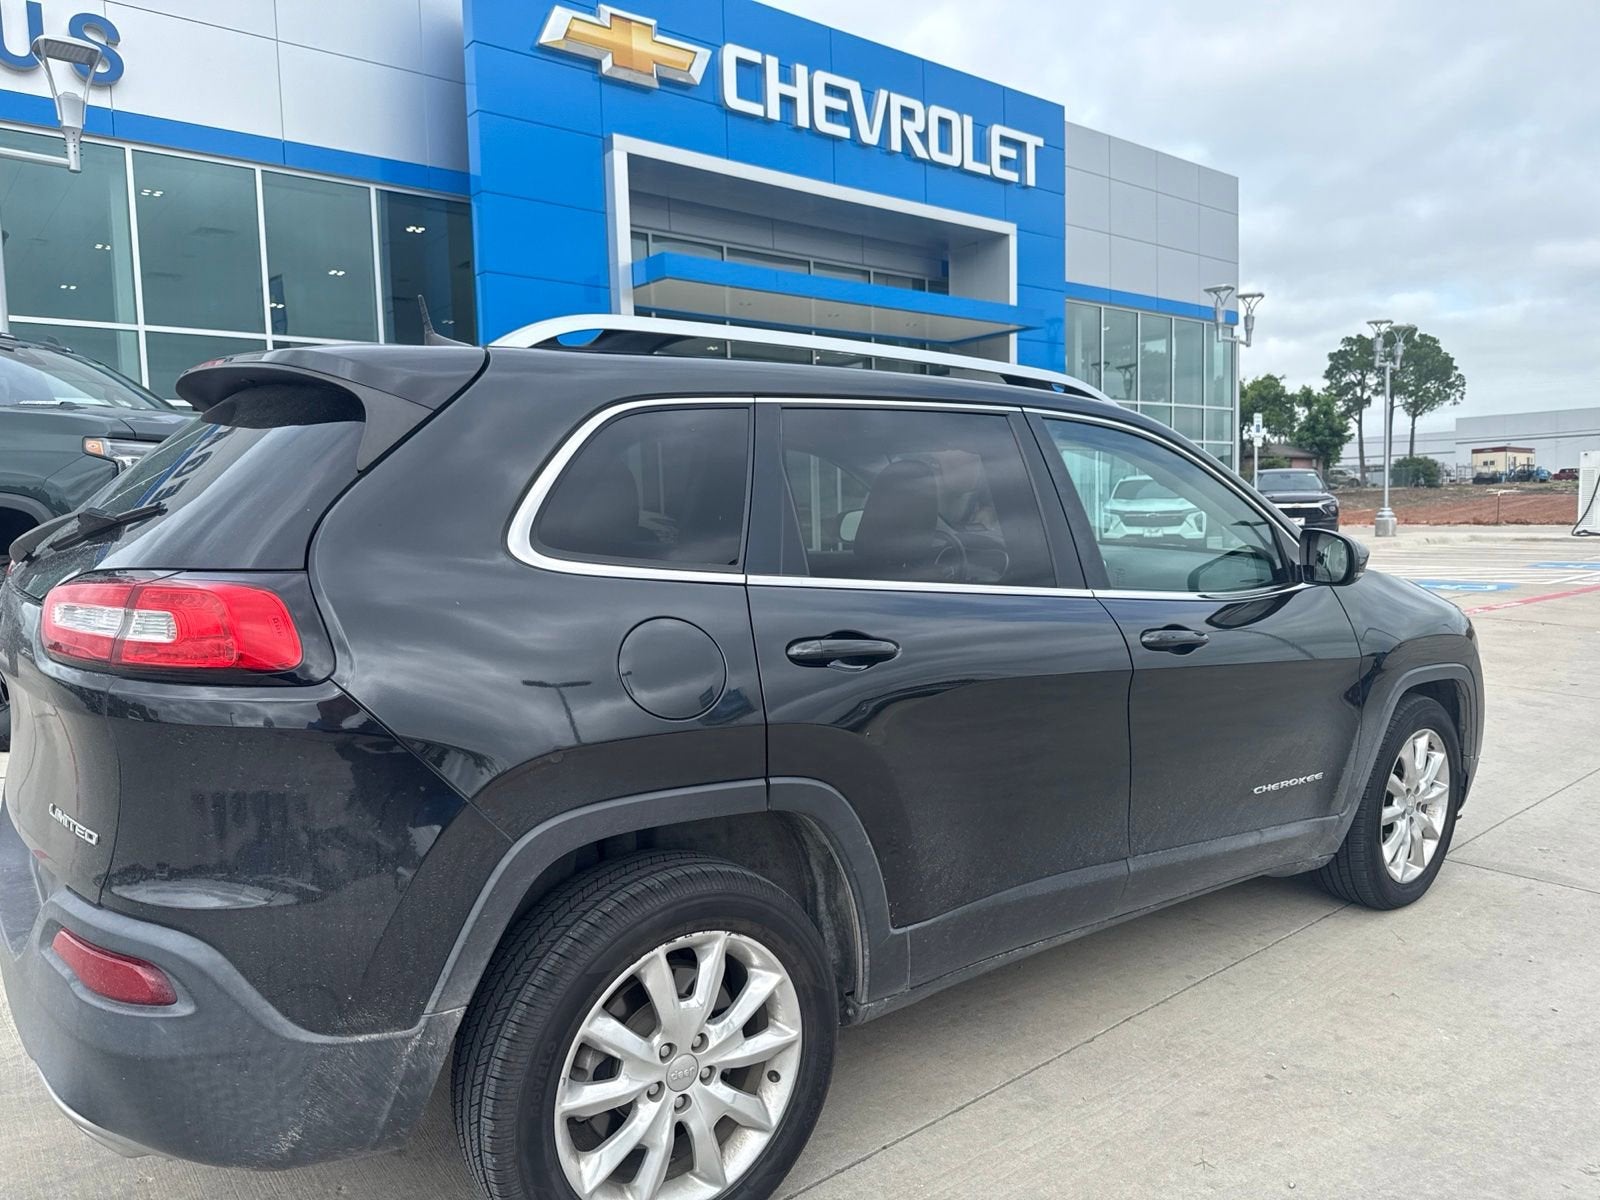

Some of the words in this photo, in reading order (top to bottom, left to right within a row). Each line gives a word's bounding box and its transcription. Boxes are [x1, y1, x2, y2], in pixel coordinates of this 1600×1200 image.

[720, 43, 1044, 188] CHEVROLET
[1253, 771, 1324, 795] CHEROKEE
[48, 803, 98, 846] LIMITED
